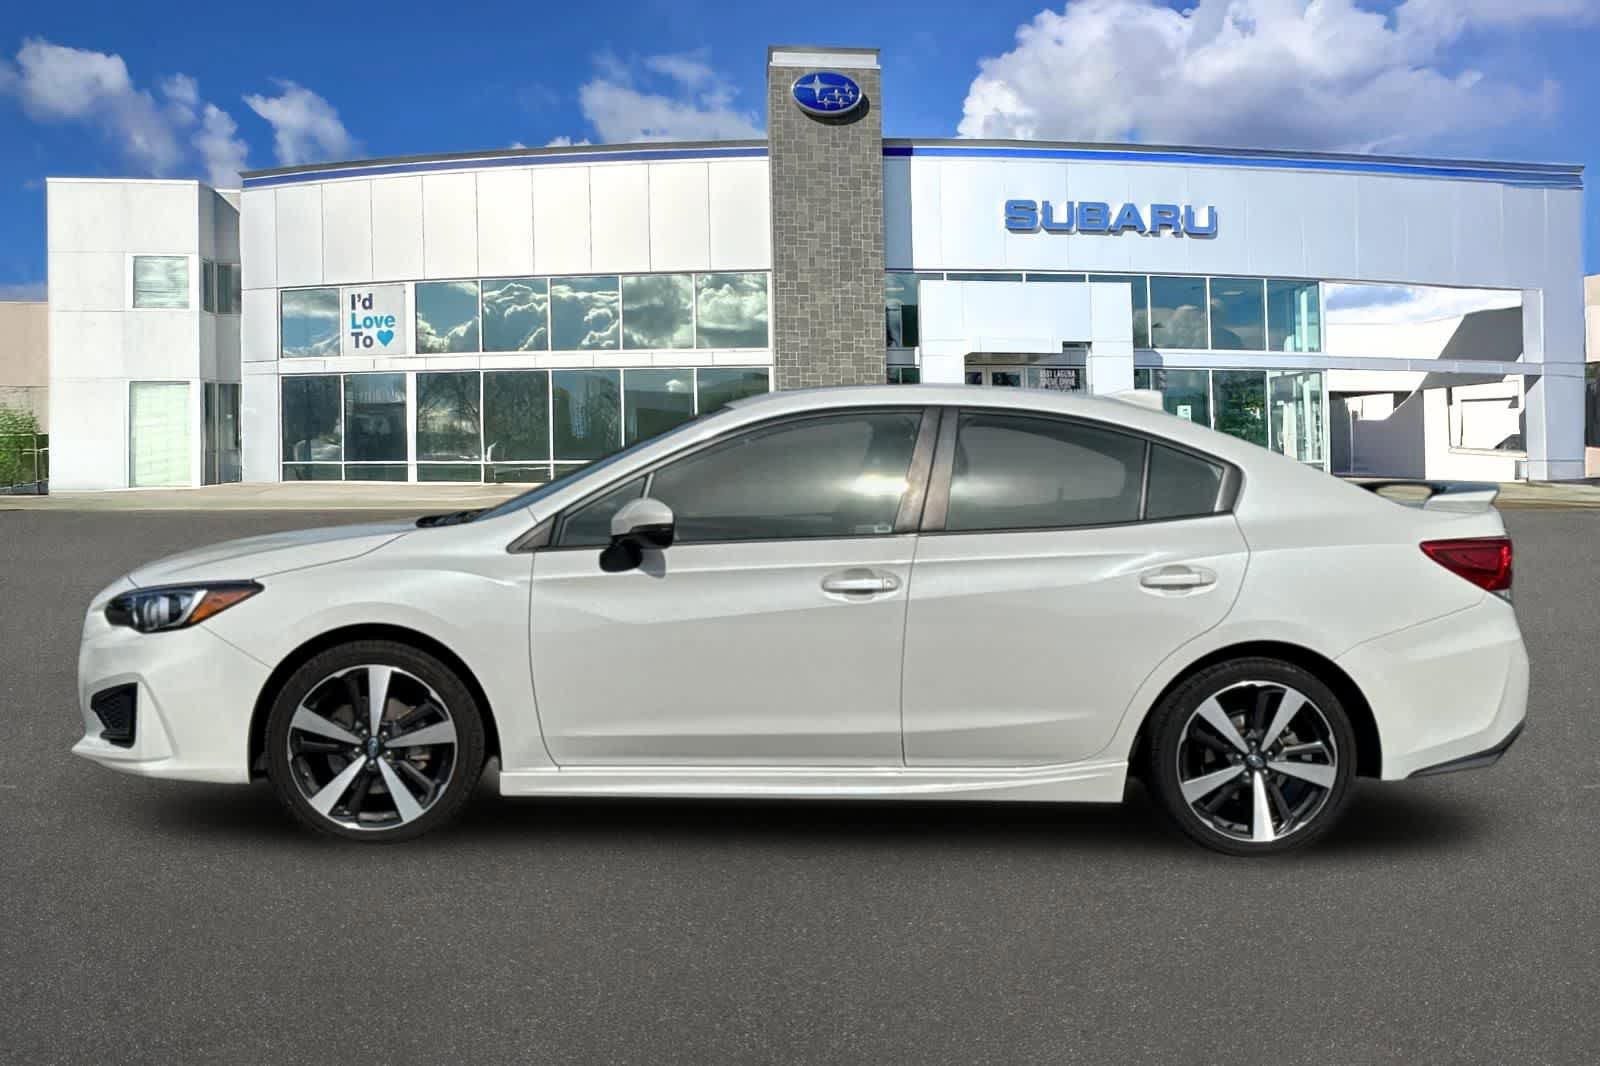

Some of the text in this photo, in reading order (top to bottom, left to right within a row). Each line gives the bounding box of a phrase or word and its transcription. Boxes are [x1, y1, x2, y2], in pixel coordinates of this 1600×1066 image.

[1005, 199, 1217, 237] SUBARU
[351, 312, 396, 329] Love
[351, 331, 373, 348] To
